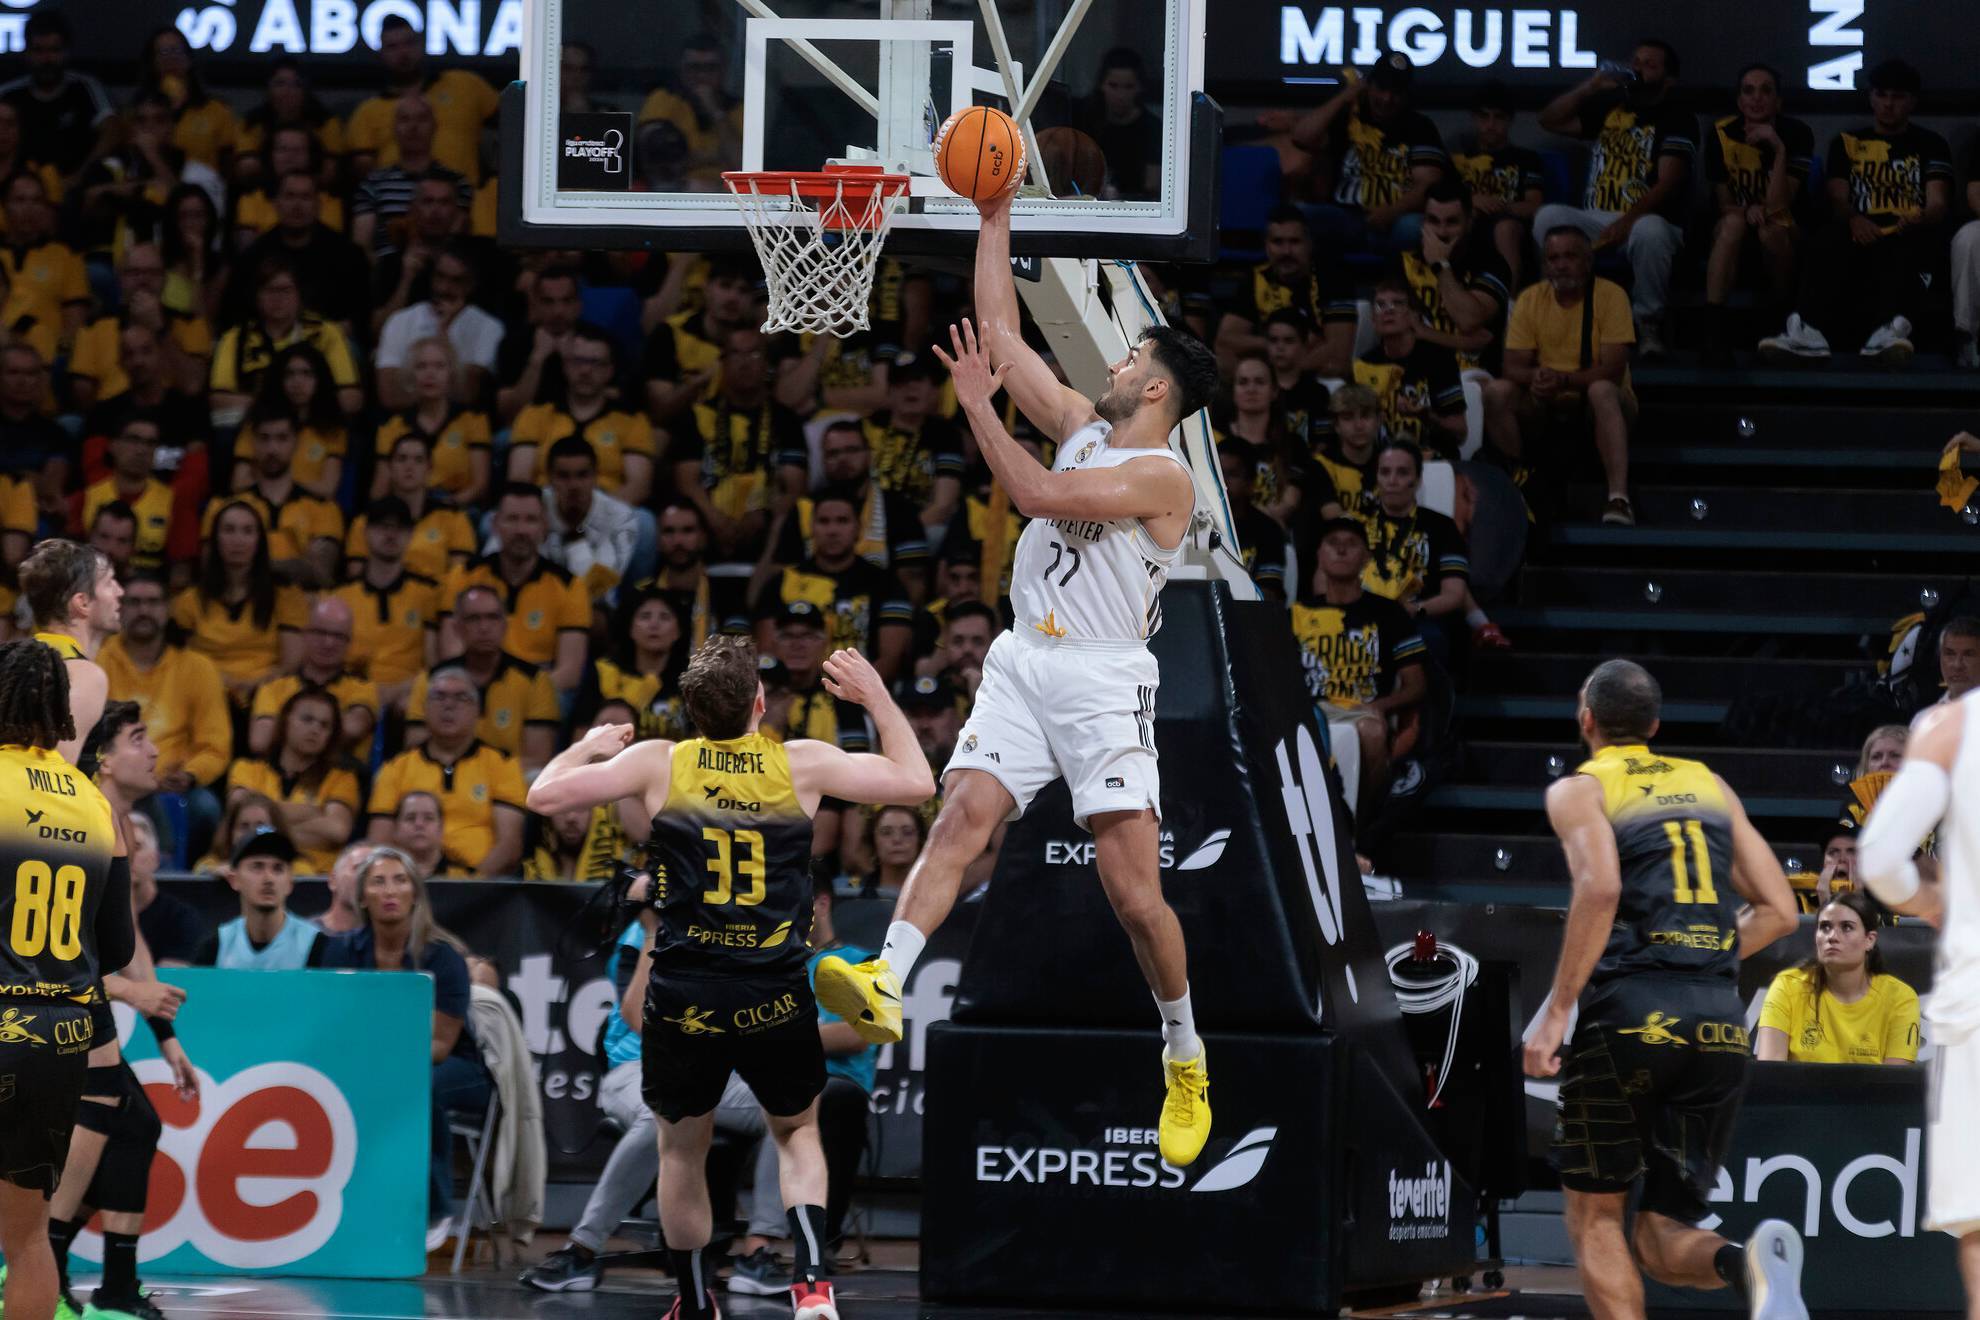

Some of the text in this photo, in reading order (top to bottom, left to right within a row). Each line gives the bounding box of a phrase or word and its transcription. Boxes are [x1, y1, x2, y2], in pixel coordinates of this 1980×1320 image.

[1279, 6, 1597, 68] MIGUEL
[565, 147, 616, 157] PLAYOFF
[991, 151, 1004, 177] acb
[1043, 541, 1082, 588] 77
[697, 747, 766, 775] ALDERETE
[25, 766, 77, 797] MILLS
[701, 826, 767, 906] 33
[1045, 841, 1175, 869] EXPS
[1662, 819, 1720, 905] 11
[10, 859, 87, 962] 88
[733, 993, 798, 1029] CICAR
[54, 1015, 95, 1045] CICA
[1105, 1128, 1159, 1145] IBER
[976, 1146, 1187, 1189] EXPRESS
